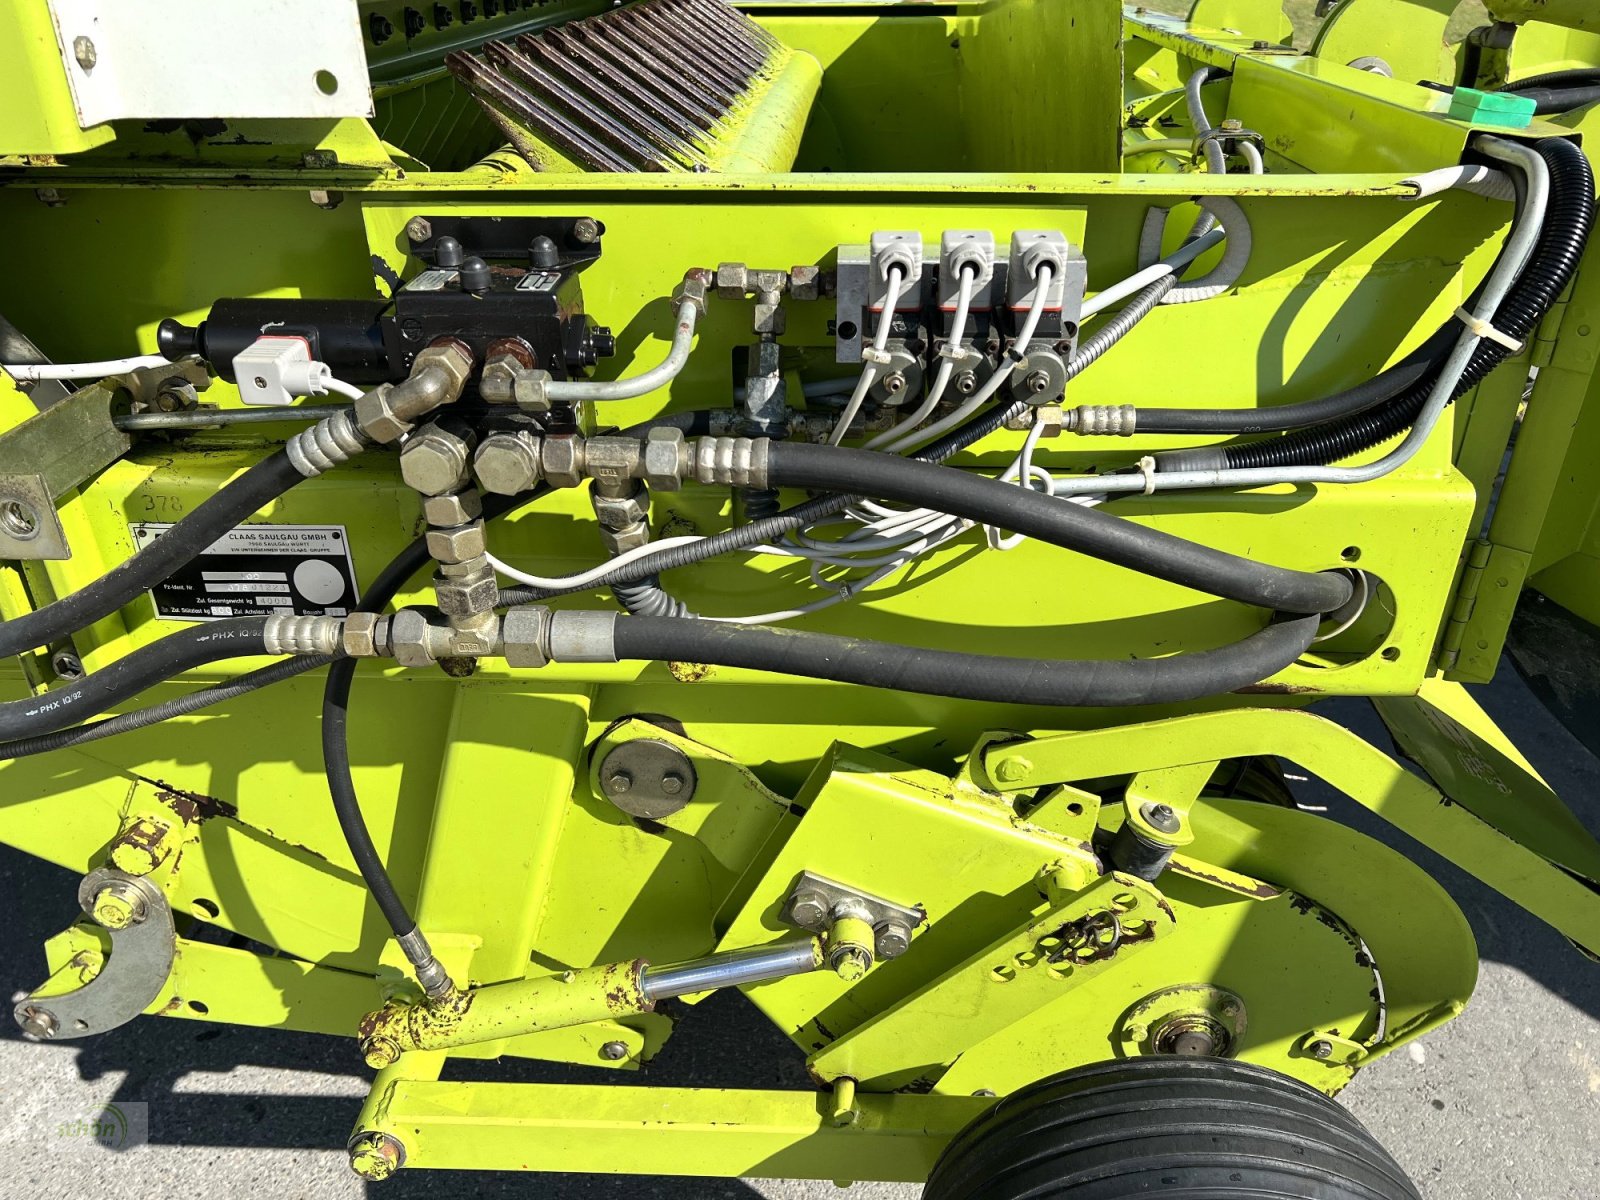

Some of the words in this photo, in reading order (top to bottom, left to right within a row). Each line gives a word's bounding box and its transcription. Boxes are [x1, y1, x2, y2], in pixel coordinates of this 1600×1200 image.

[142, 495, 182, 512] 378
[258, 533, 299, 541] SAULGAU
[207, 597, 244, 605] Gesamtgewicht
[212, 630, 235, 641] PHX
[40, 700, 61, 713] PHX
